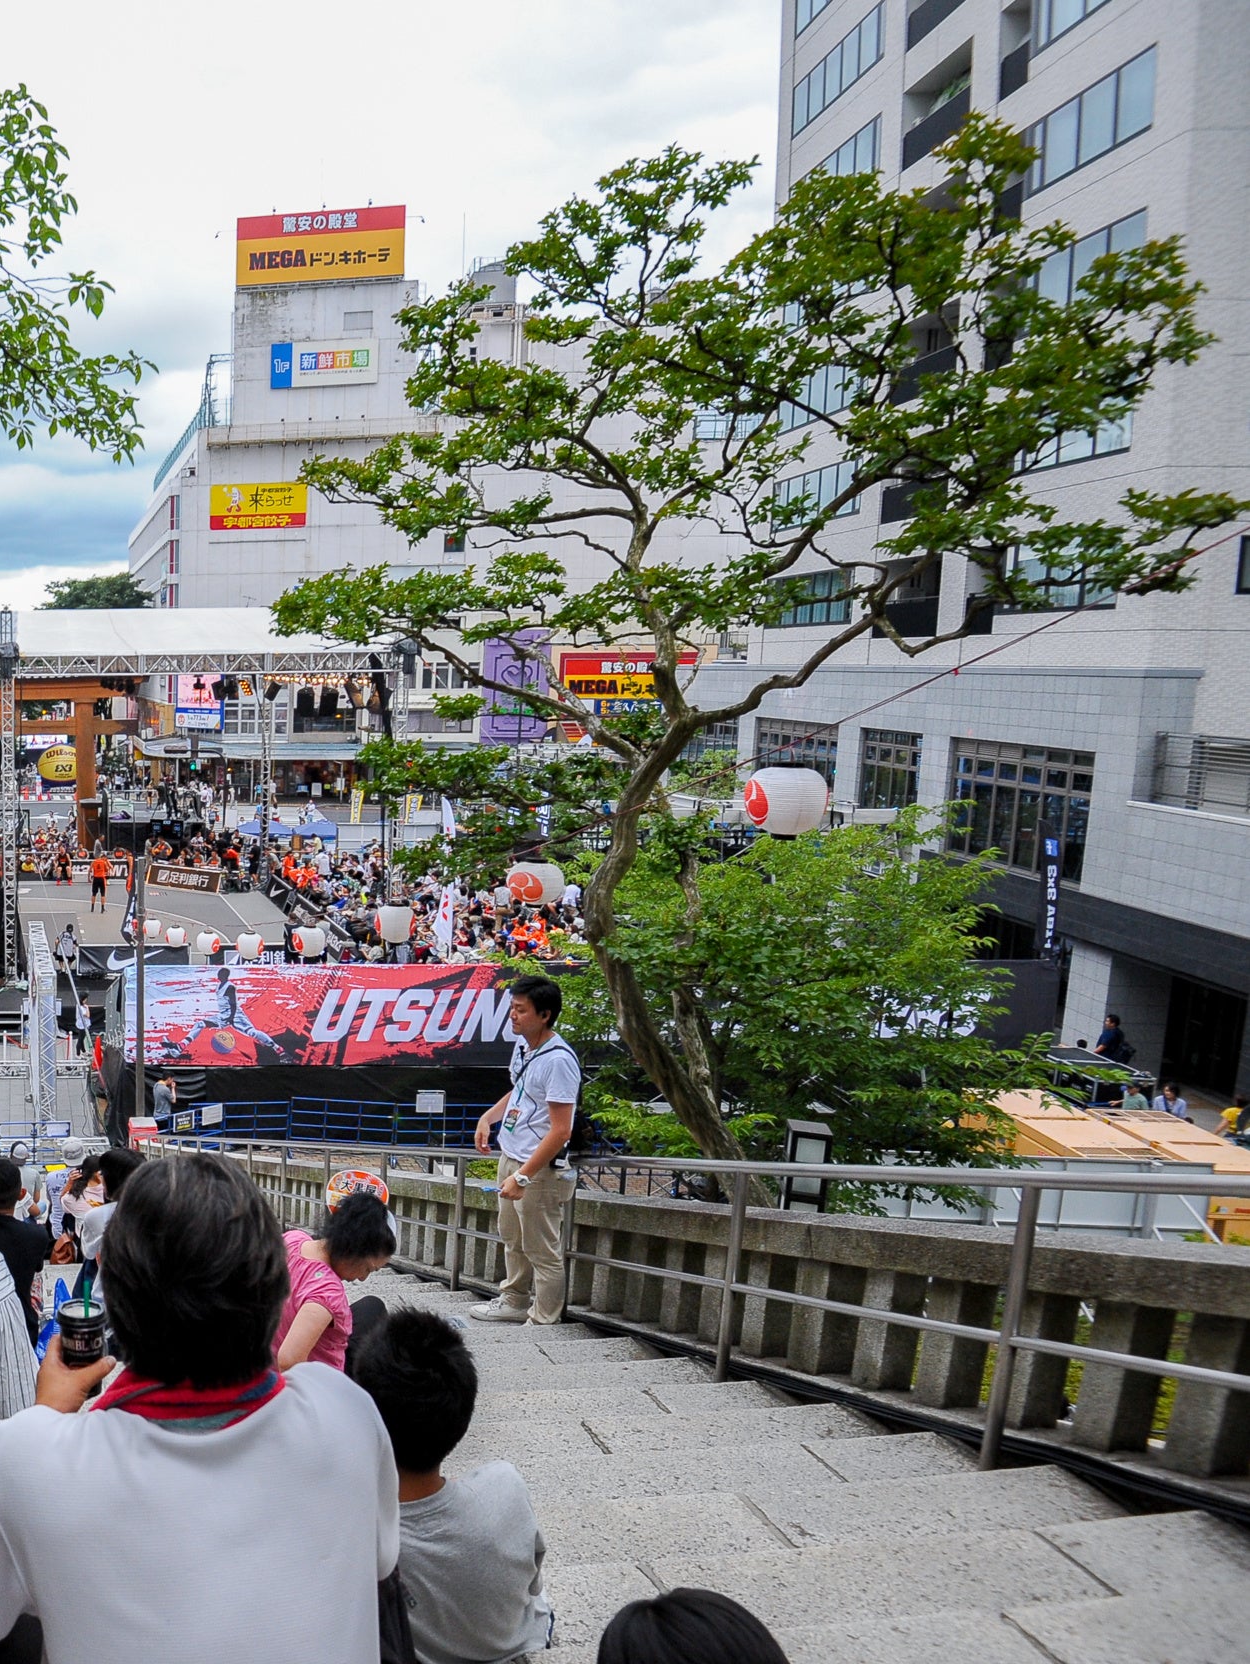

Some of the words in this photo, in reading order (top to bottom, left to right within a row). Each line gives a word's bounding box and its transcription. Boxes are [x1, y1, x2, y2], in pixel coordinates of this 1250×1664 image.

[282, 212, 358, 233] 驚安の殿堂
[249, 249, 307, 270] MEGA
[273, 358, 290, 373] 1F
[301, 351, 369, 369] 新鮮市場
[249, 486, 294, 512] 来らっせ
[223, 515, 291, 528] 宇都宮餃子
[601, 661, 654, 673] 驚安の殿
[569, 680, 618, 694] MEGA
[169, 871, 210, 888] 足利銀行
[310, 989, 522, 1043] UTSUN
